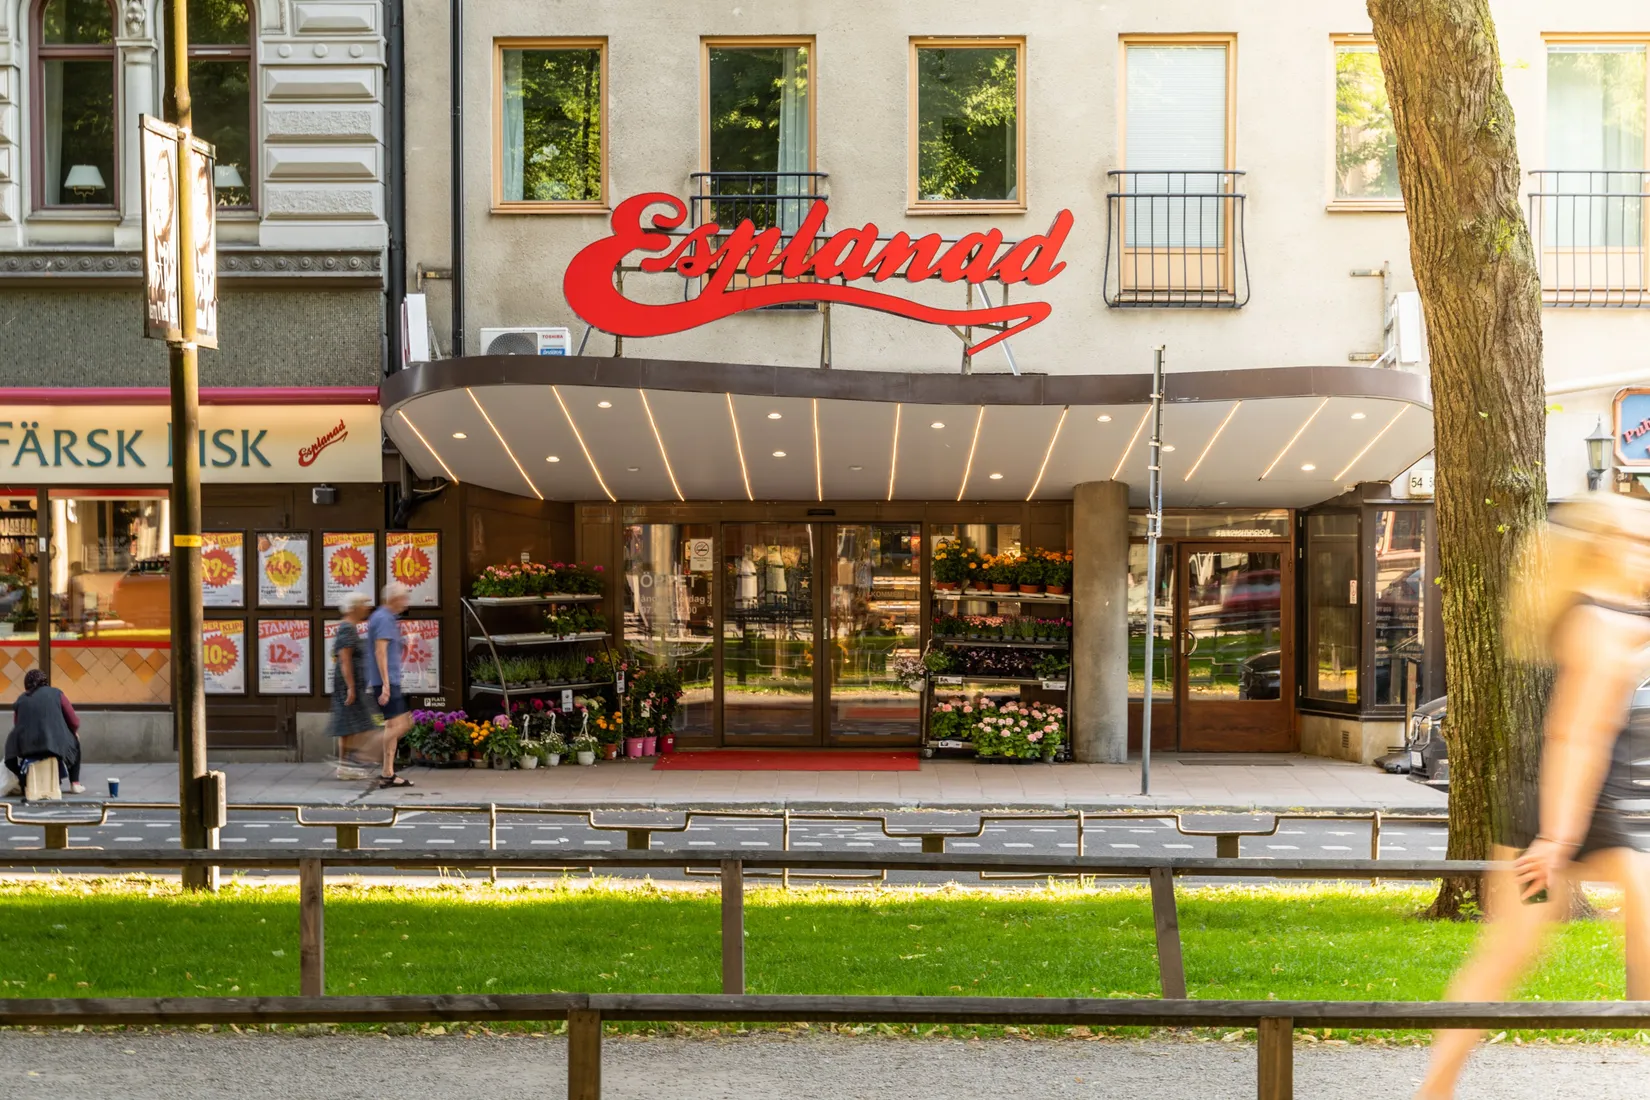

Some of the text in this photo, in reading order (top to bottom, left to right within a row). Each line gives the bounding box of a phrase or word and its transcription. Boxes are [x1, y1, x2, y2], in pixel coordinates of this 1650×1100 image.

[563, 192, 1075, 355] Esplanad
[298, 419, 349, 467] Esplanad
[1411, 477, 1423, 488] 54
[331, 557, 367, 577] 20:-
[395, 557, 428, 577] 10:-
[640, 571, 698, 588] ÖPPET
[203, 622, 220, 632] PER
[203, 645, 235, 665] 10:-
[269, 644, 300, 663] 12:-
